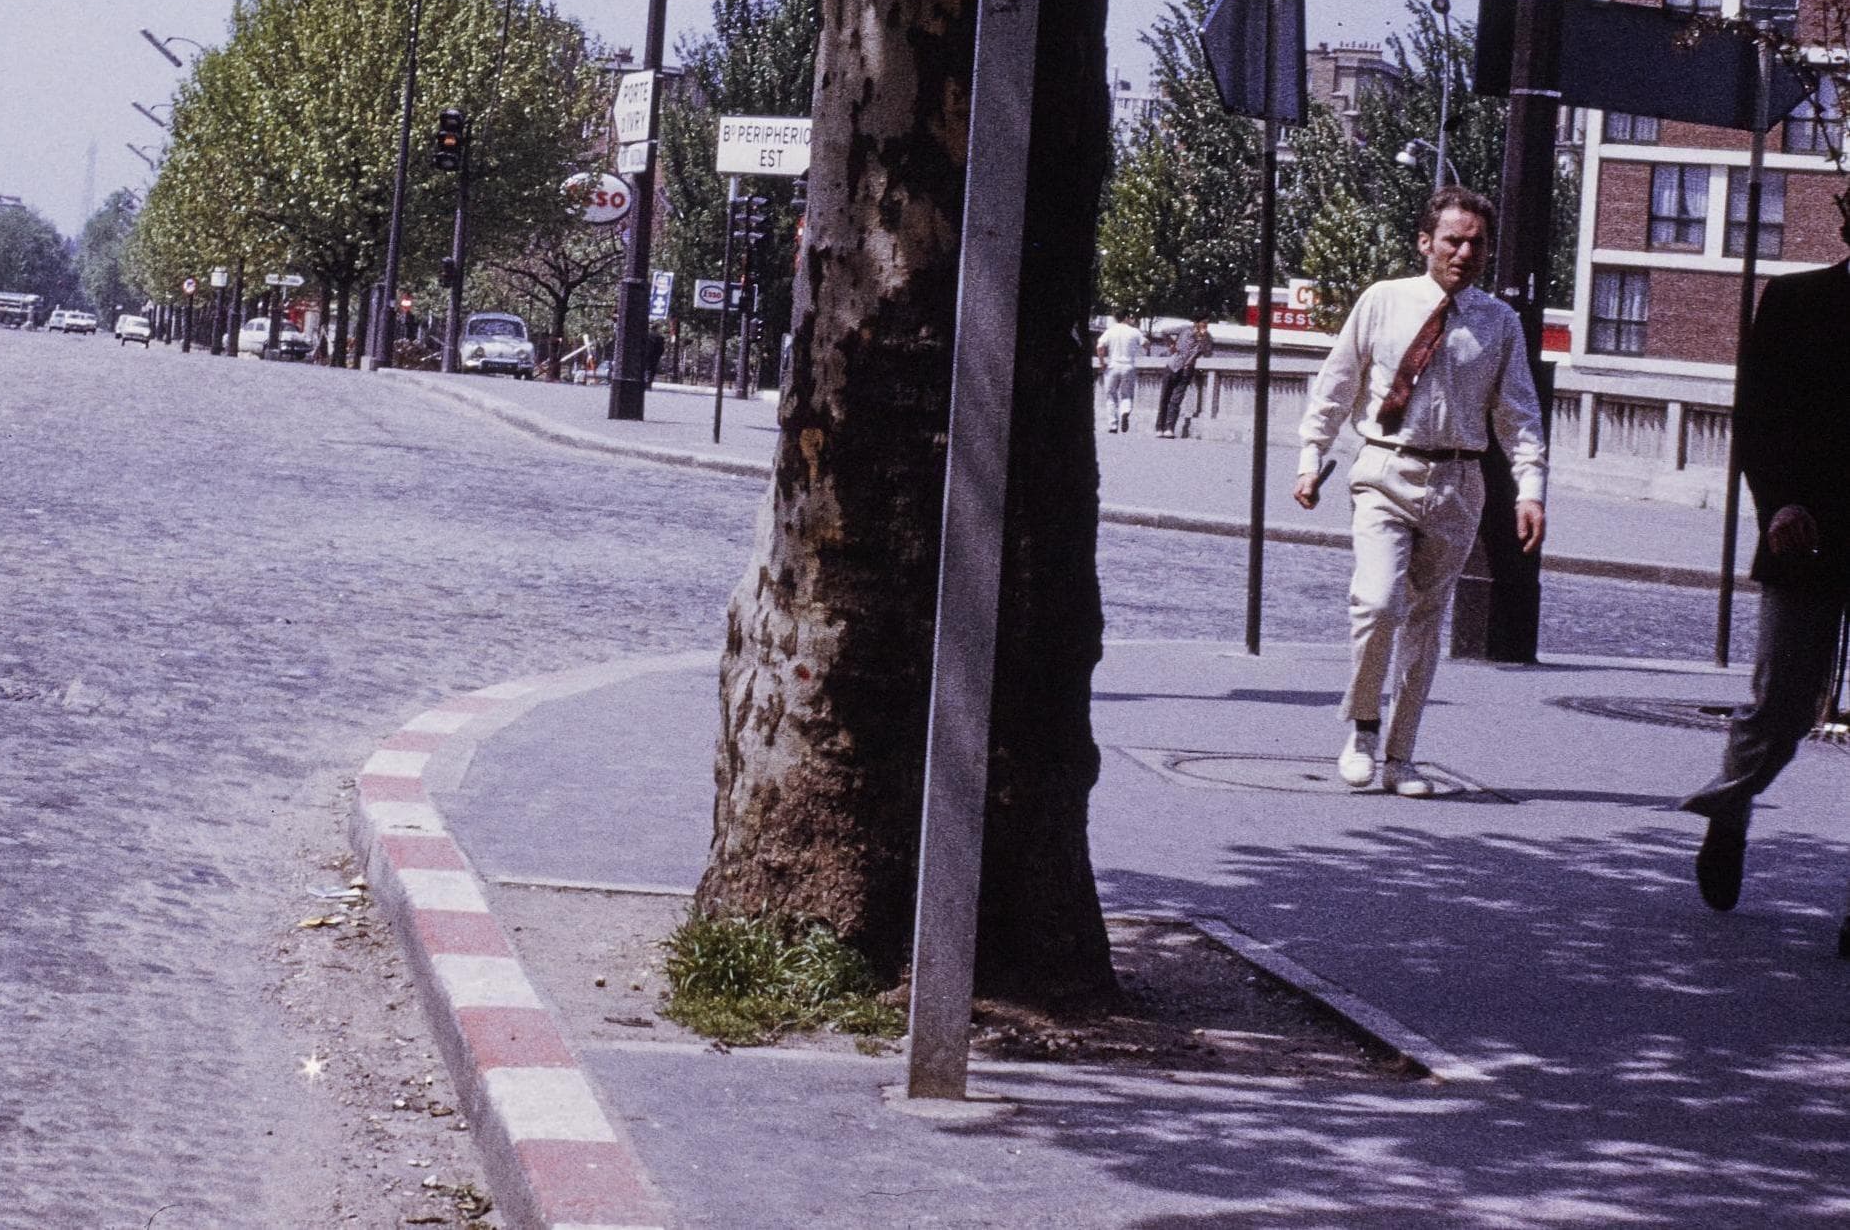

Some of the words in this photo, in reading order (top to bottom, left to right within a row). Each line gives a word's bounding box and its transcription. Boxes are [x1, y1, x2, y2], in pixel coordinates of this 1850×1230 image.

[623, 80, 650, 103] PORTE
[738, 122, 811, 146] PÉRIPHÉRIQ
[759, 149, 784, 168] EST
